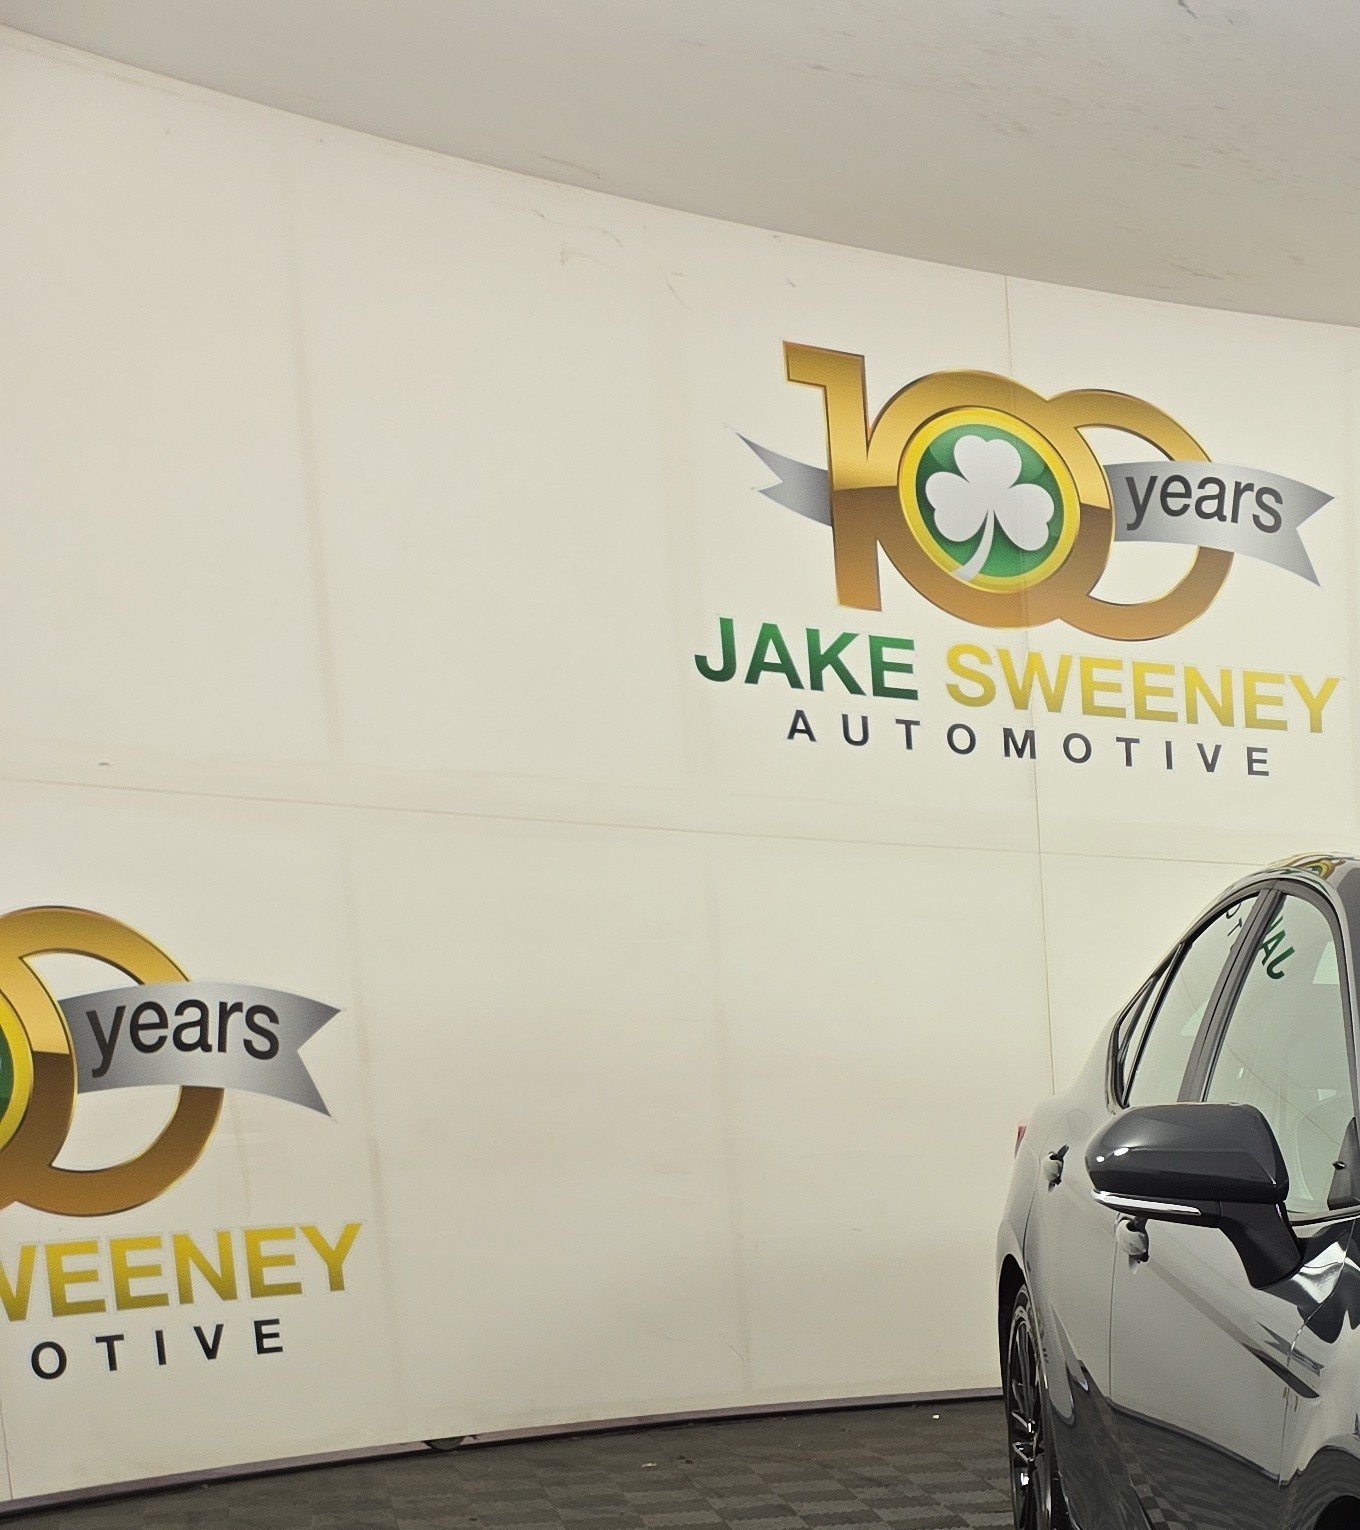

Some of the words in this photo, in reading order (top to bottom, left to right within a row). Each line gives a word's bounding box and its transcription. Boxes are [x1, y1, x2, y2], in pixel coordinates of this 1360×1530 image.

[1124, 469, 1284, 534] years
[694, 617, 920, 702] JAKE
[945, 643, 1340, 734] SWEENEY
[787, 709, 1271, 777] AUTOMOTIVE
[86, 998, 281, 1078] years
